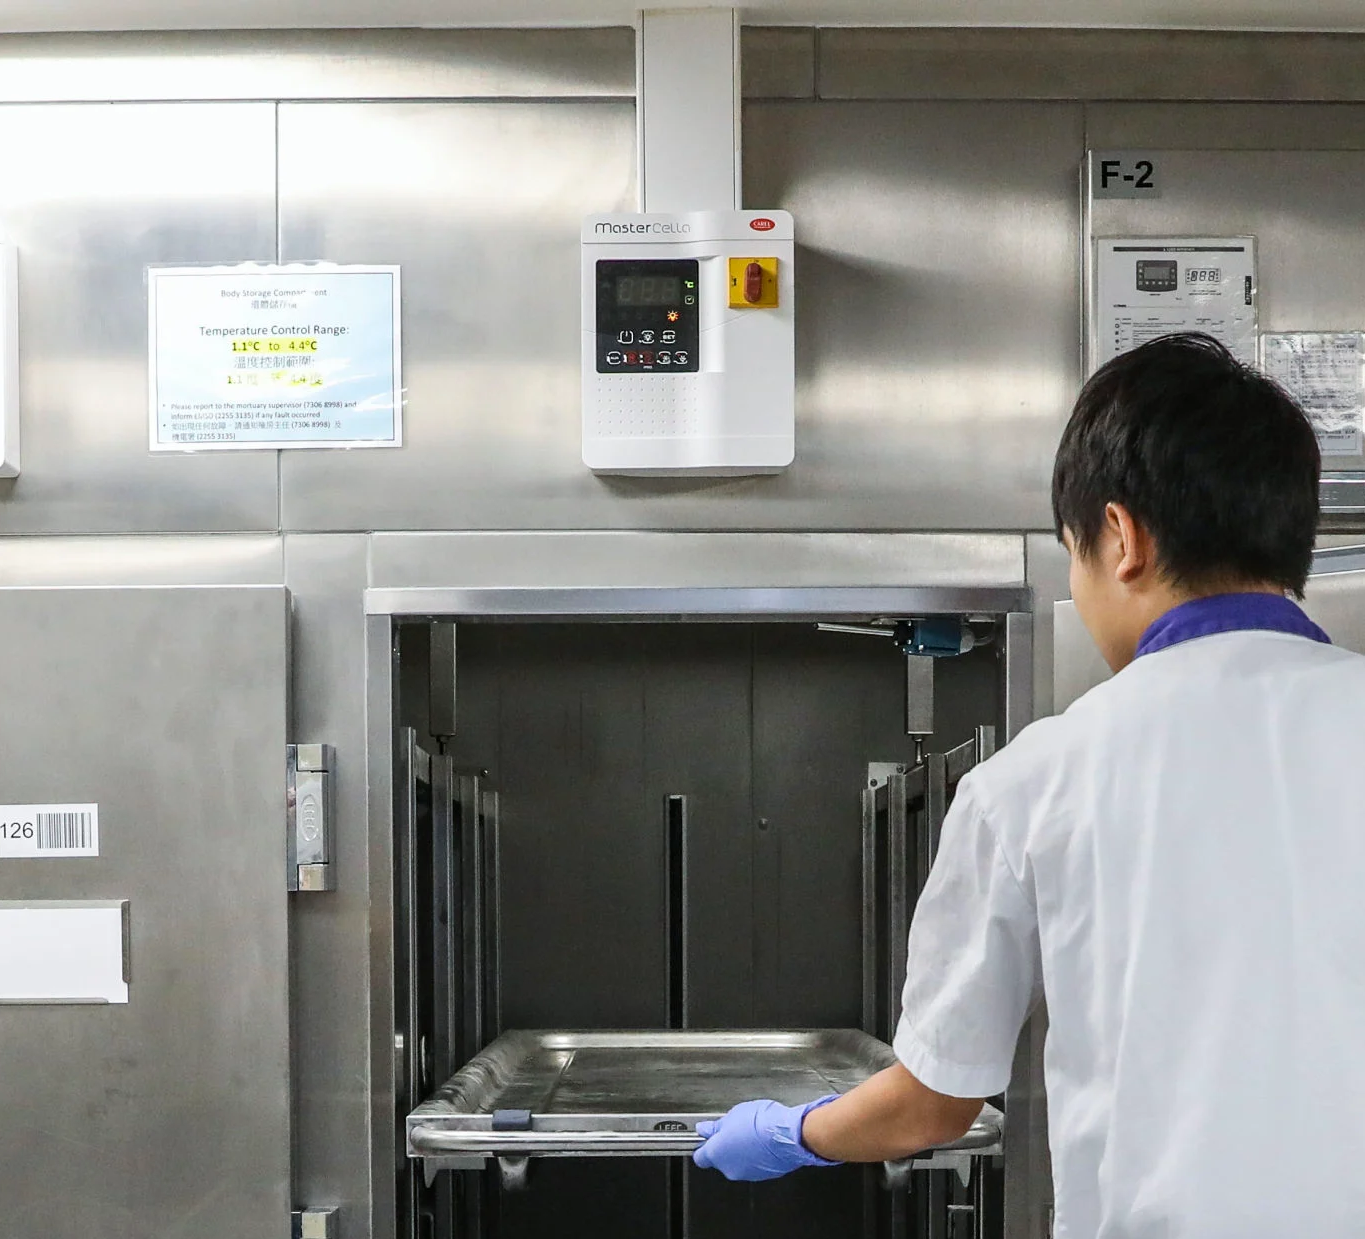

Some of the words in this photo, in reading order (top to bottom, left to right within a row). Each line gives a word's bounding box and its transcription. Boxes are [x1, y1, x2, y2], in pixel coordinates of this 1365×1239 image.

[1101, 161, 1154, 189] F-2
[221, 289, 240, 299] Body
[241, 289, 272, 299] Storage
[200, 326, 268, 337] Temperature
[271, 325, 311, 335] Control
[313, 325, 350, 337] Range:
[268, 341, 280, 351] to
[261, 412, 273, 420] any
[0, 822, 34, 839] 126
